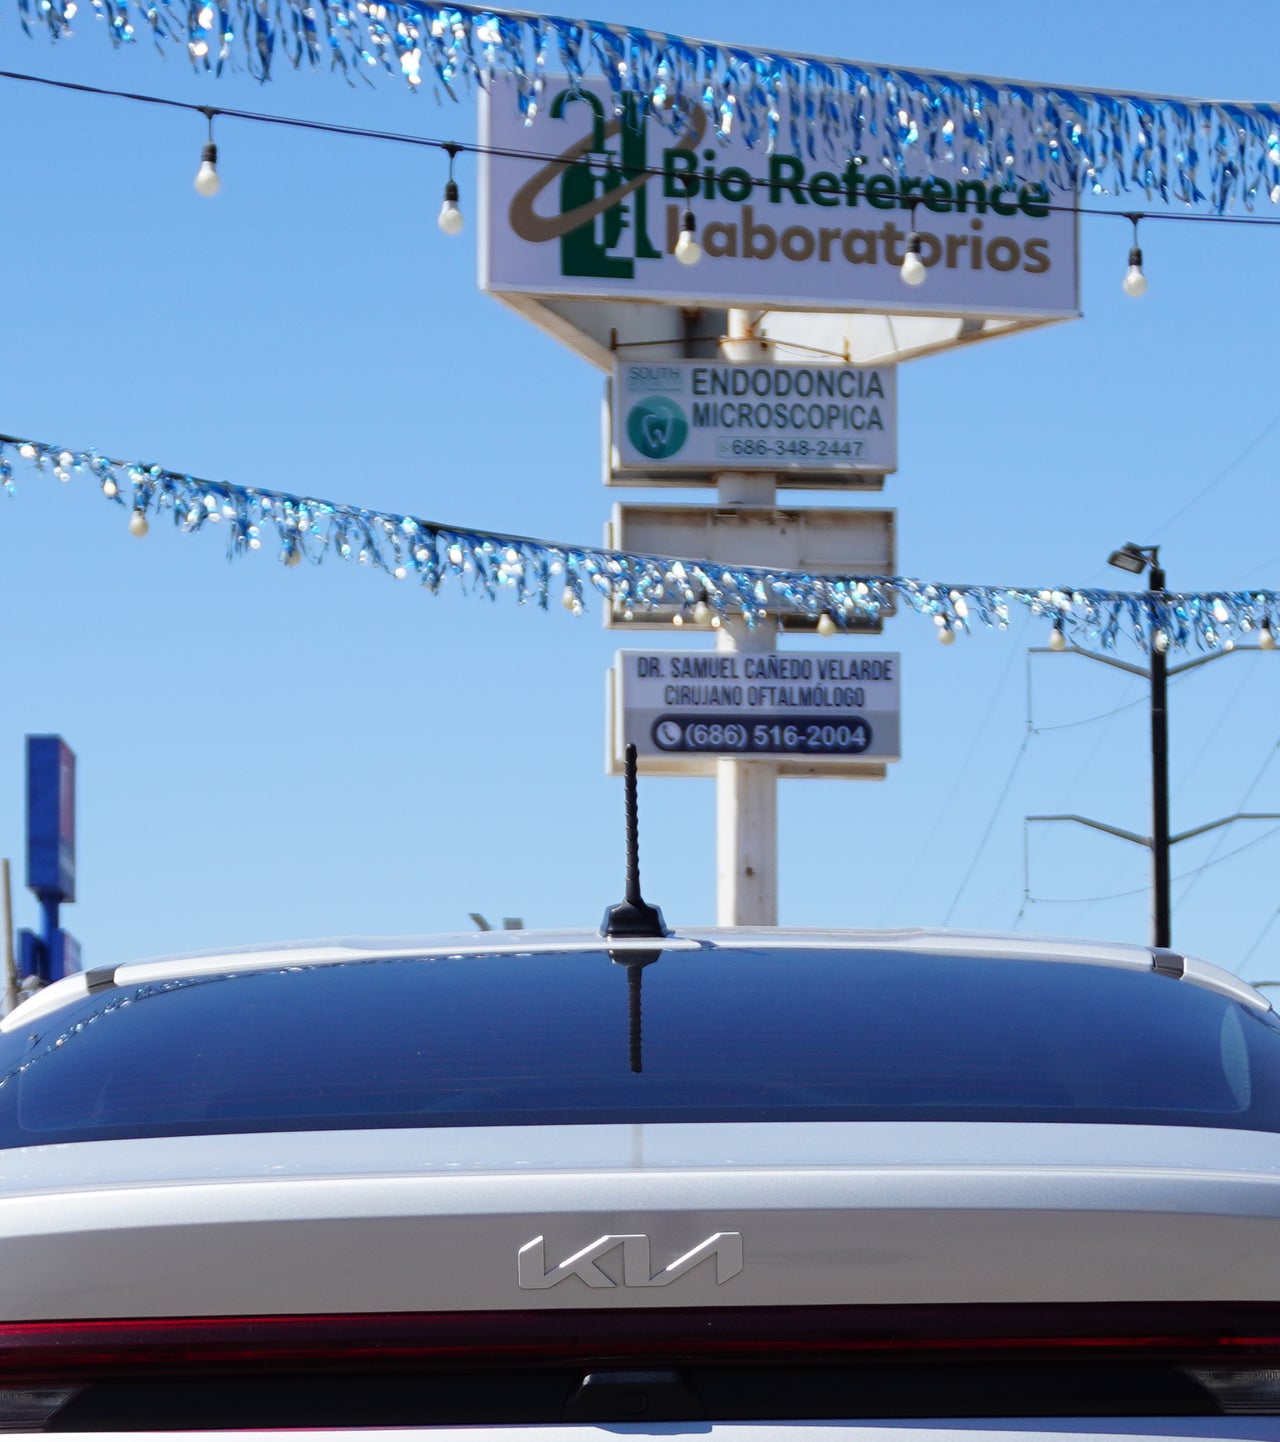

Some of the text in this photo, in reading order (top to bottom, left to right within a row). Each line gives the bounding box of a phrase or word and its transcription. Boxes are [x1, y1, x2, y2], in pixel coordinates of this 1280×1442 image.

[663, 148, 752, 202] Bio
[666, 204, 1051, 274] Laboratorios
[691, 367, 885, 399] ENDODONCIA
[691, 402, 884, 431] MICROSCOPICA
[731, 438, 864, 458] 686-348-2447
[637, 653, 893, 682] DR. SAMUEL CAÑEDO VELARDE
[664, 682, 866, 708] CIRUJANO OFTALMÓLOGO
[685, 721, 866, 749] (686) 516-2004
